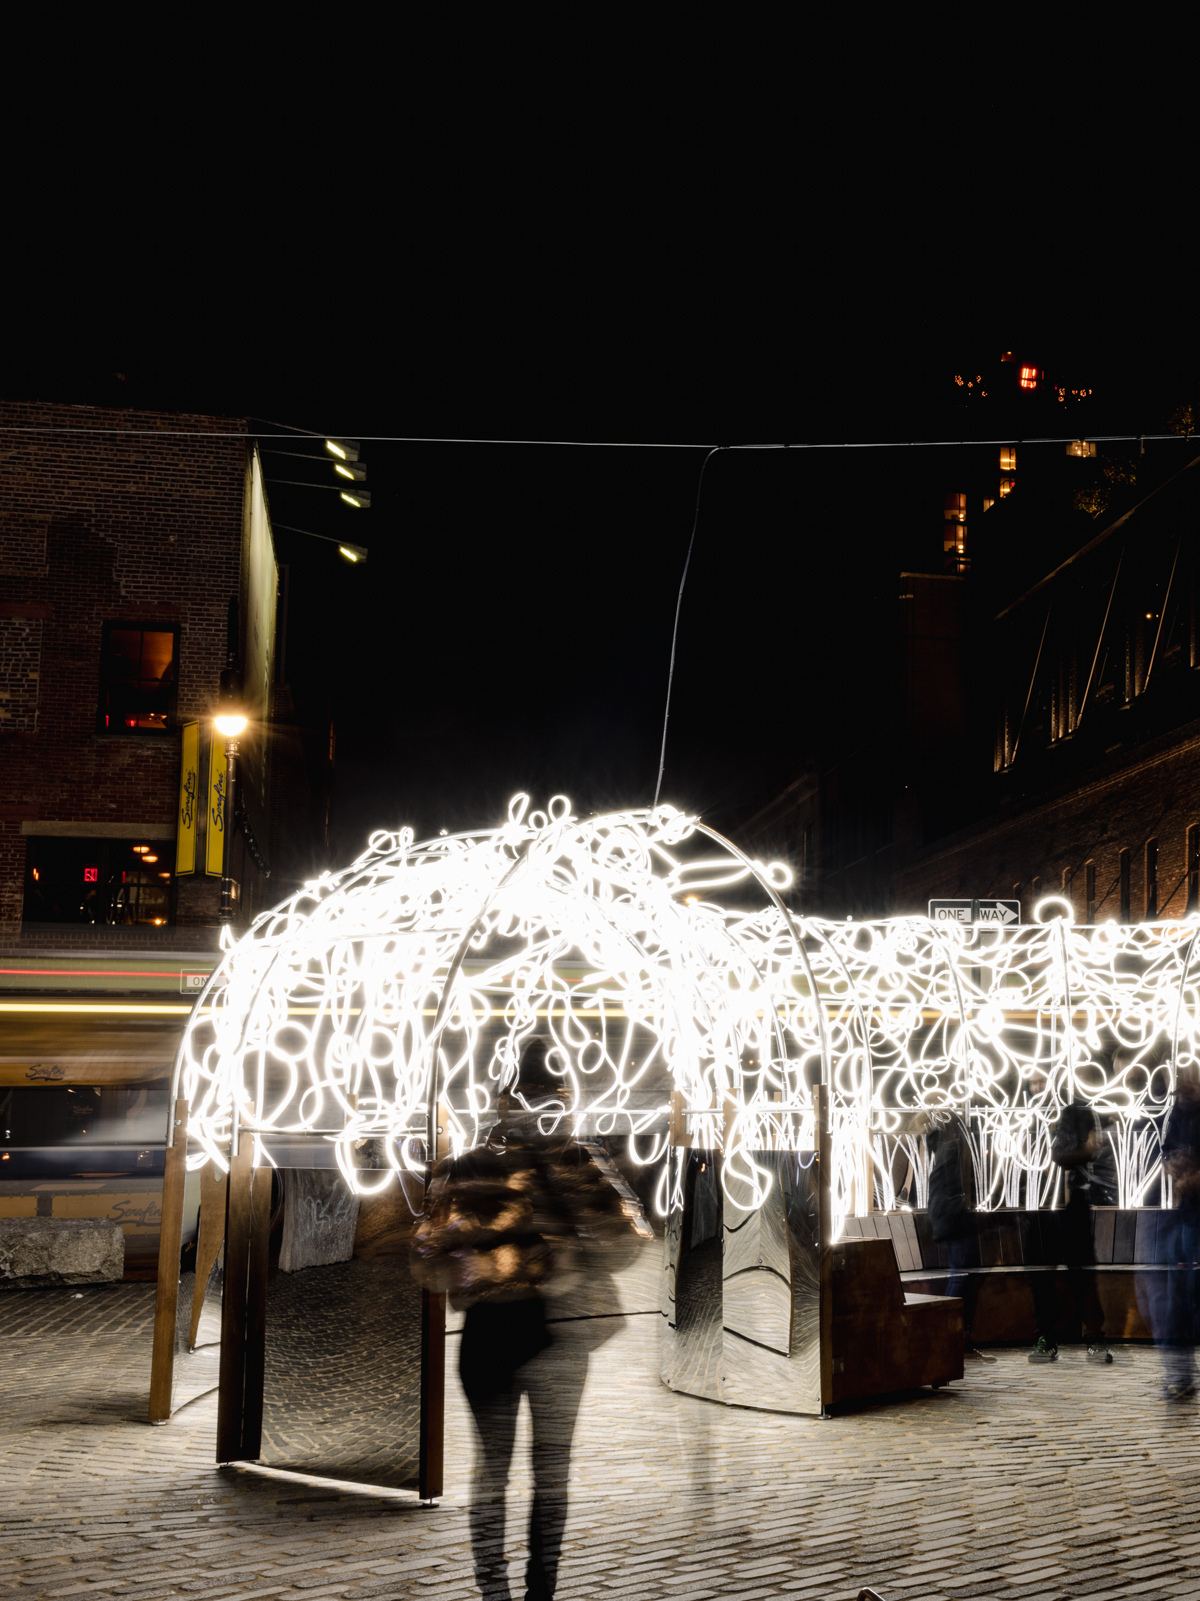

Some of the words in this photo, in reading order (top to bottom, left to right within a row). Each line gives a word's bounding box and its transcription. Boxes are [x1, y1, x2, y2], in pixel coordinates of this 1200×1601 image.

[181, 769, 196, 830] Serafina
[212, 772, 226, 833] Serafina
[938, 909, 965, 921] ONE
[980, 909, 1008, 921] WAY
